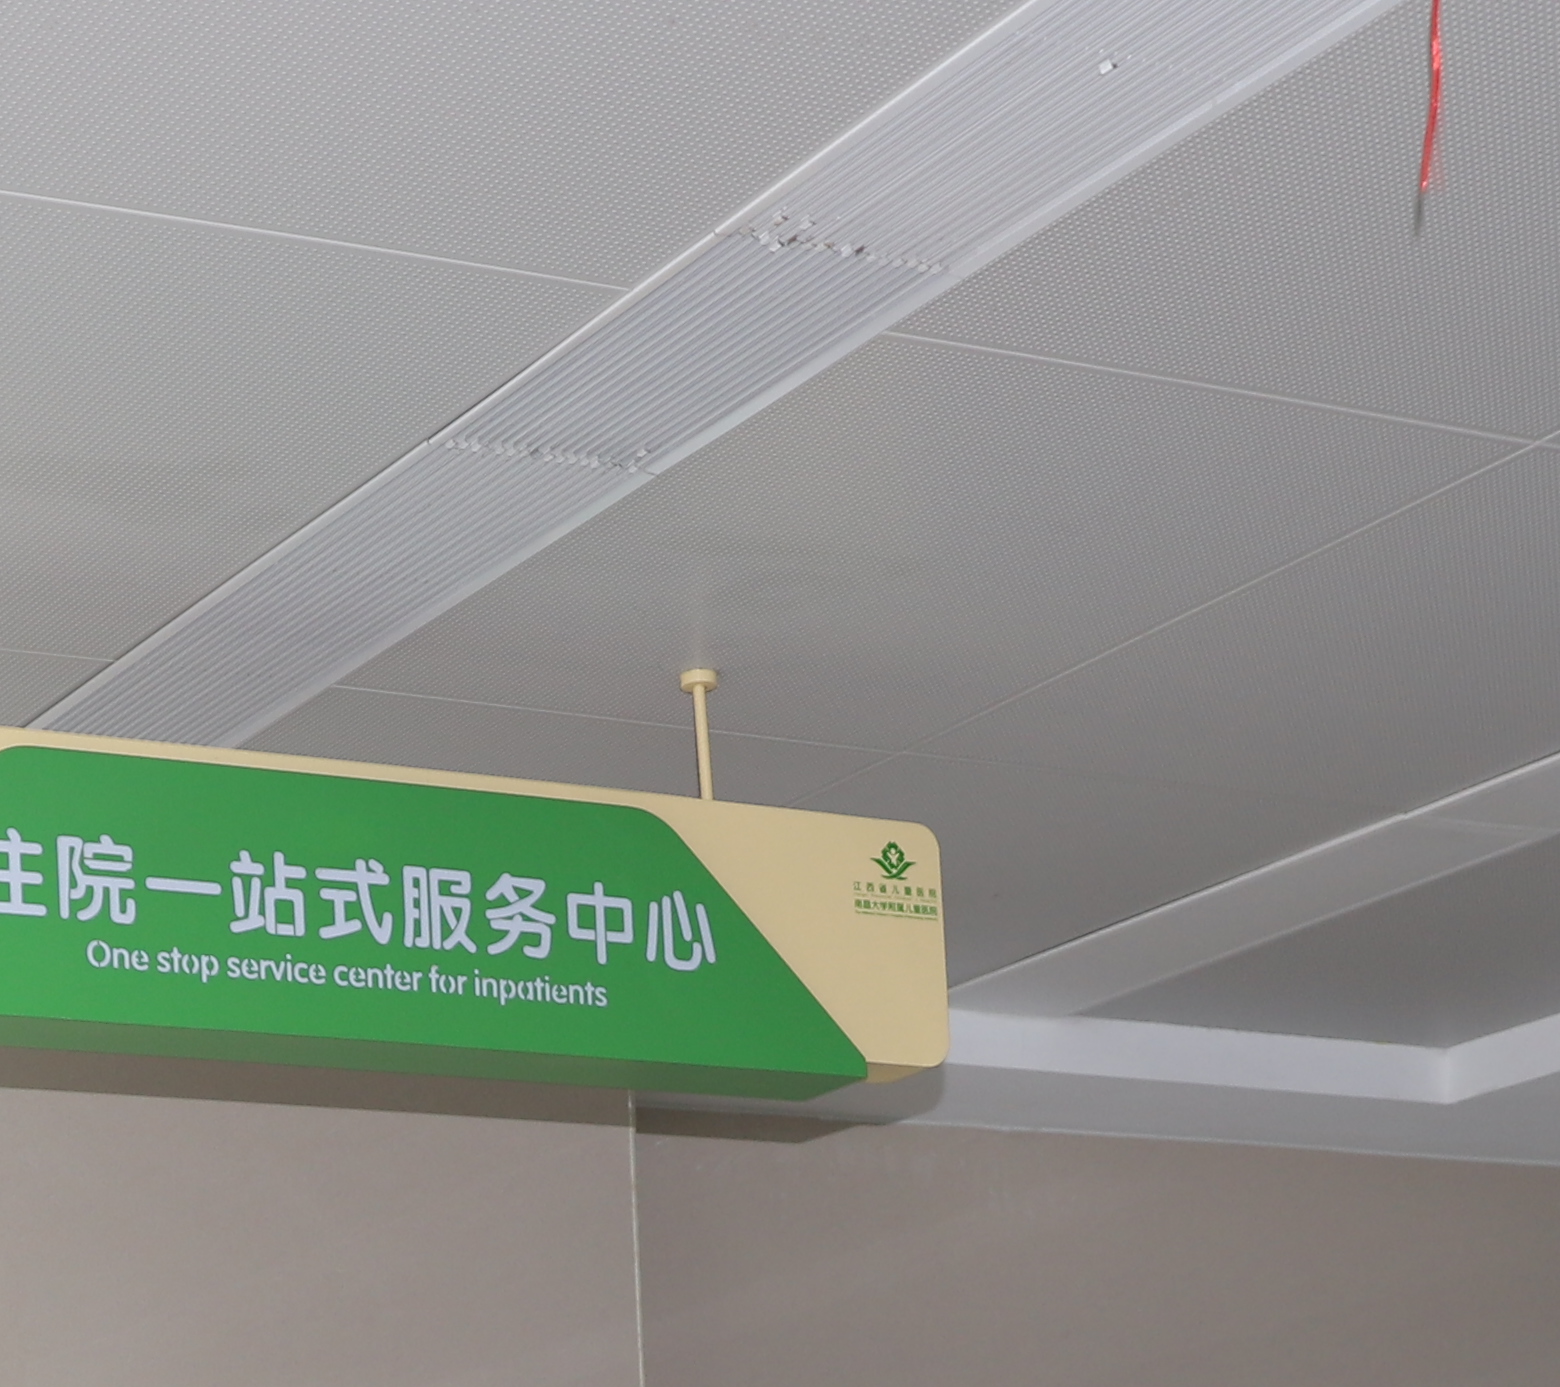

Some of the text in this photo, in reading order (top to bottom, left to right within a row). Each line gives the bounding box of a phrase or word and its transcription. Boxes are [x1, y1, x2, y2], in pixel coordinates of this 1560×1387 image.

[86, 939, 608, 1008] One stop service center for inpatients
